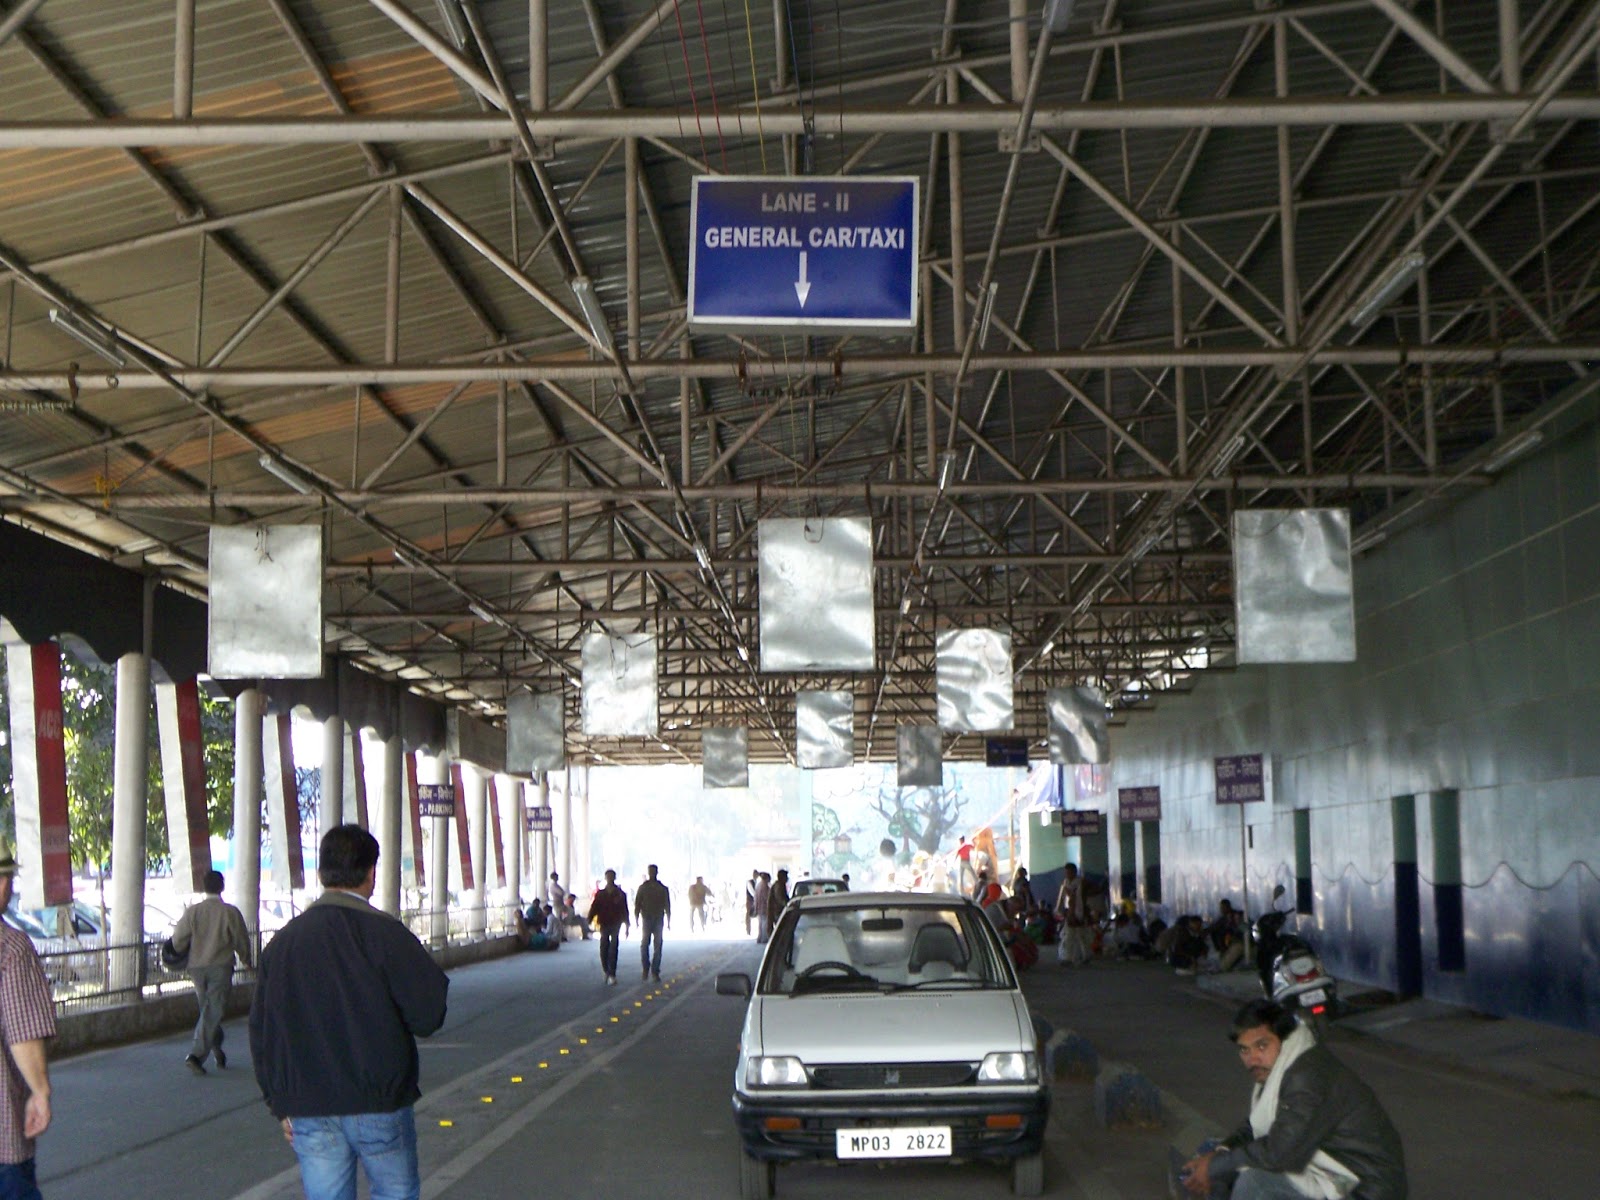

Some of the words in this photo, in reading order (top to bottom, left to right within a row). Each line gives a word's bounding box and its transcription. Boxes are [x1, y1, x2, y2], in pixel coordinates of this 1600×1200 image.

[761, 192, 816, 213] LANE
[836, 193, 849, 212] II
[705, 226, 803, 248] GENERAL
[808, 227, 905, 249] CAR/TAXI
[428, 803, 453, 815] PARKING
[851, 1136, 890, 1152] MP03
[906, 1134, 945, 1150] 2822
